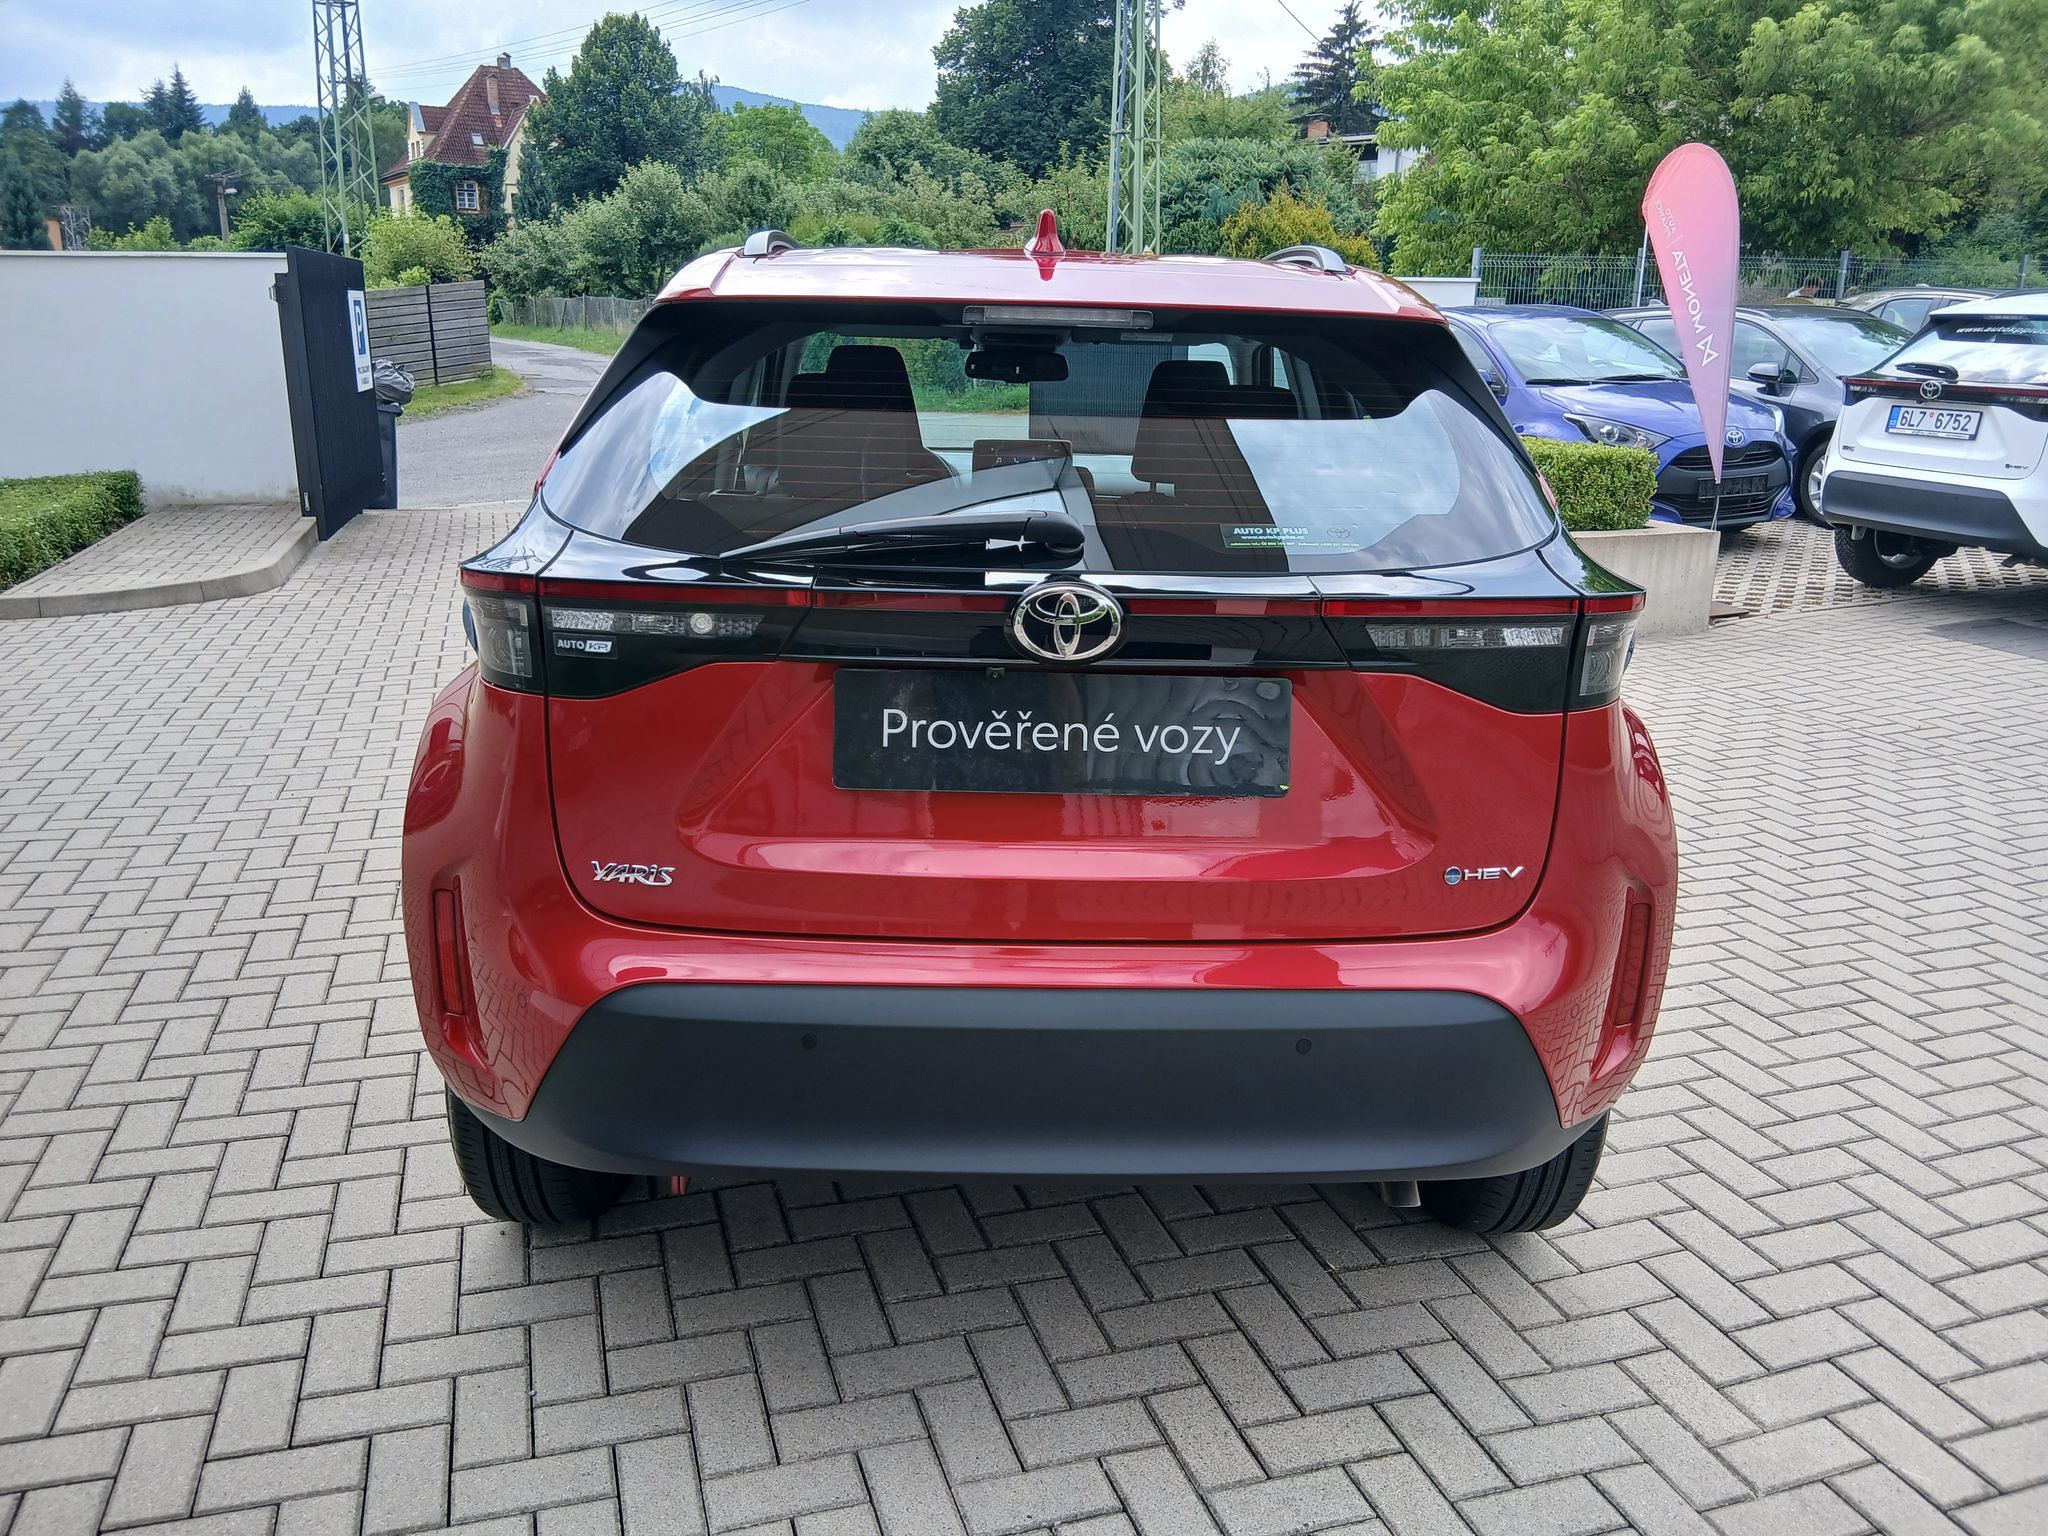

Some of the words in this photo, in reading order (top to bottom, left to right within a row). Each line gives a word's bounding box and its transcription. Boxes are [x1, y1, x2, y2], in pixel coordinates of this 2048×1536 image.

[1900, 410, 1926, 428] 6L7
[1934, 412, 1972, 432] 6752
[1233, 527, 1264, 535] AUTO
[1265, 527, 1280, 535] KP
[1282, 527, 1309, 535] PLUS
[557, 639, 585, 650] AUTO
[881, 708, 1119, 752] Prověřené
[1134, 723, 1241, 766] vozy
[1464, 866, 1524, 881] HEV
